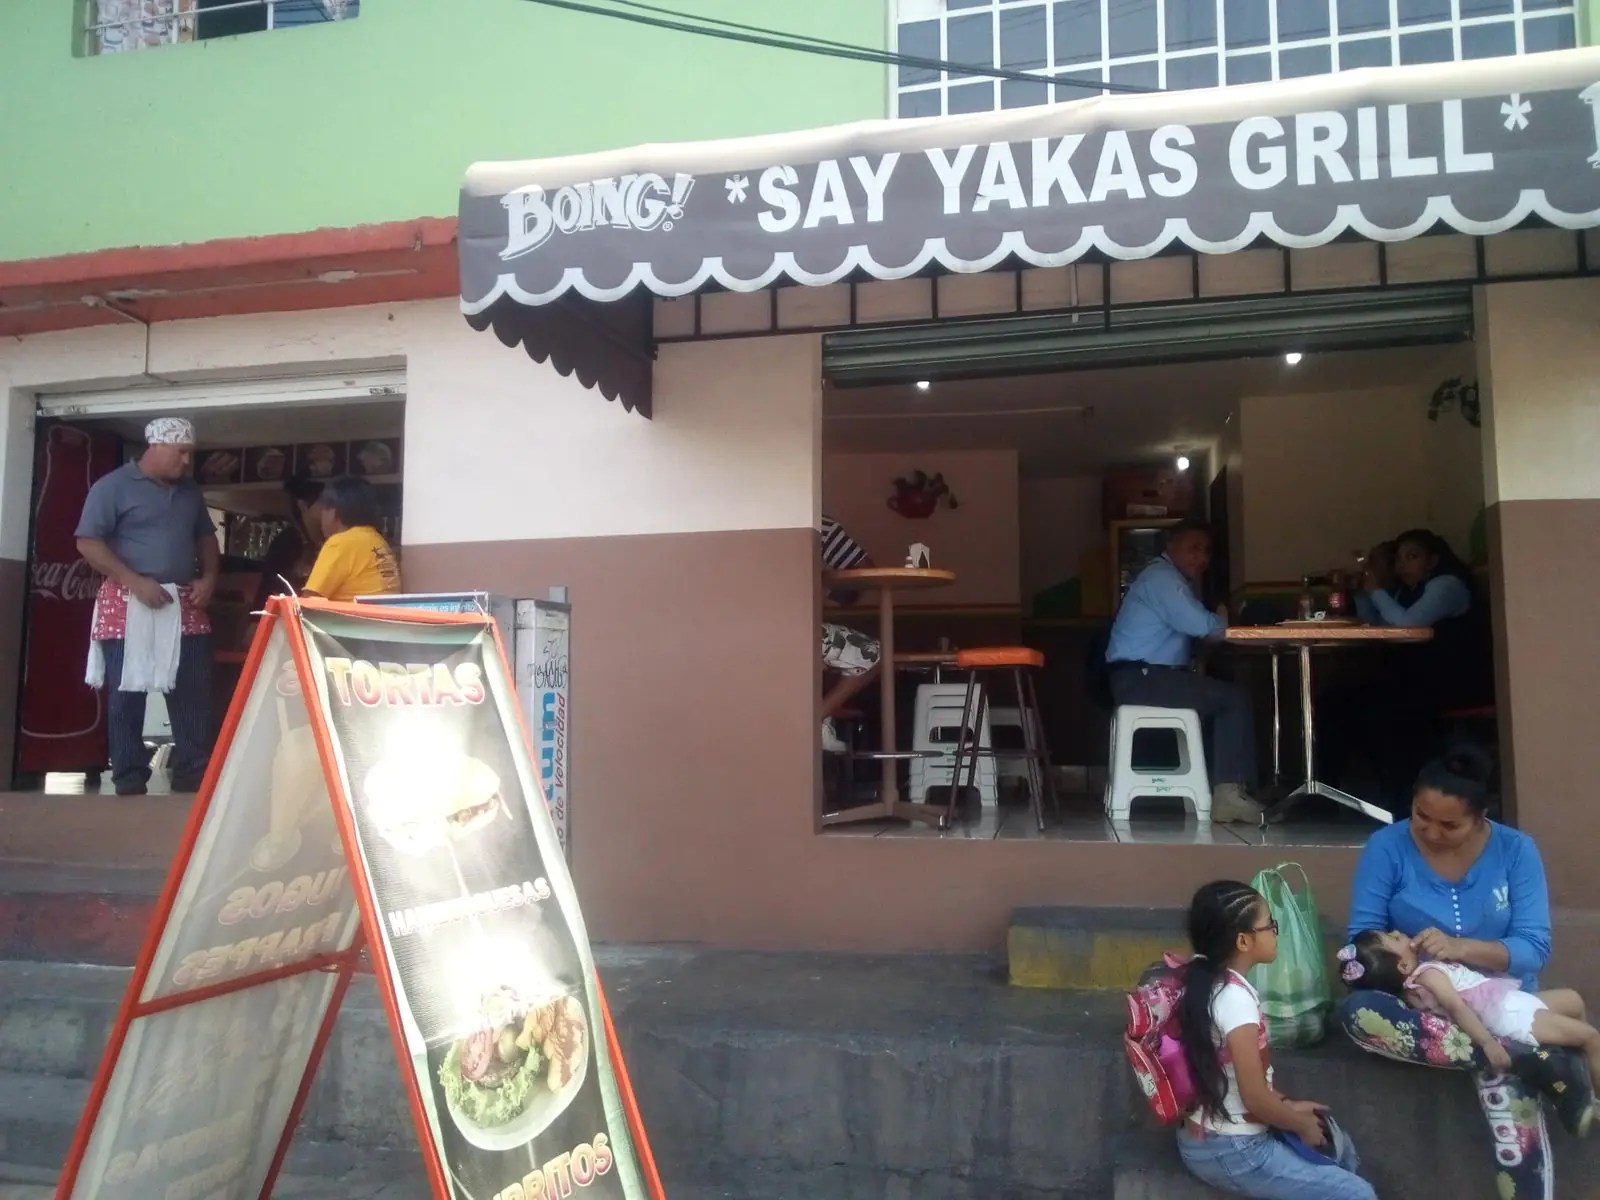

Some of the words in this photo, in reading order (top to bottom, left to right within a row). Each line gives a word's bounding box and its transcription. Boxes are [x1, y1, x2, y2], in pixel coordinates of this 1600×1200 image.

[924, 125, 1200, 214] YAKAS
[1228, 100, 1495, 190] GRILL
[324, 656, 486, 708] TORTAS
